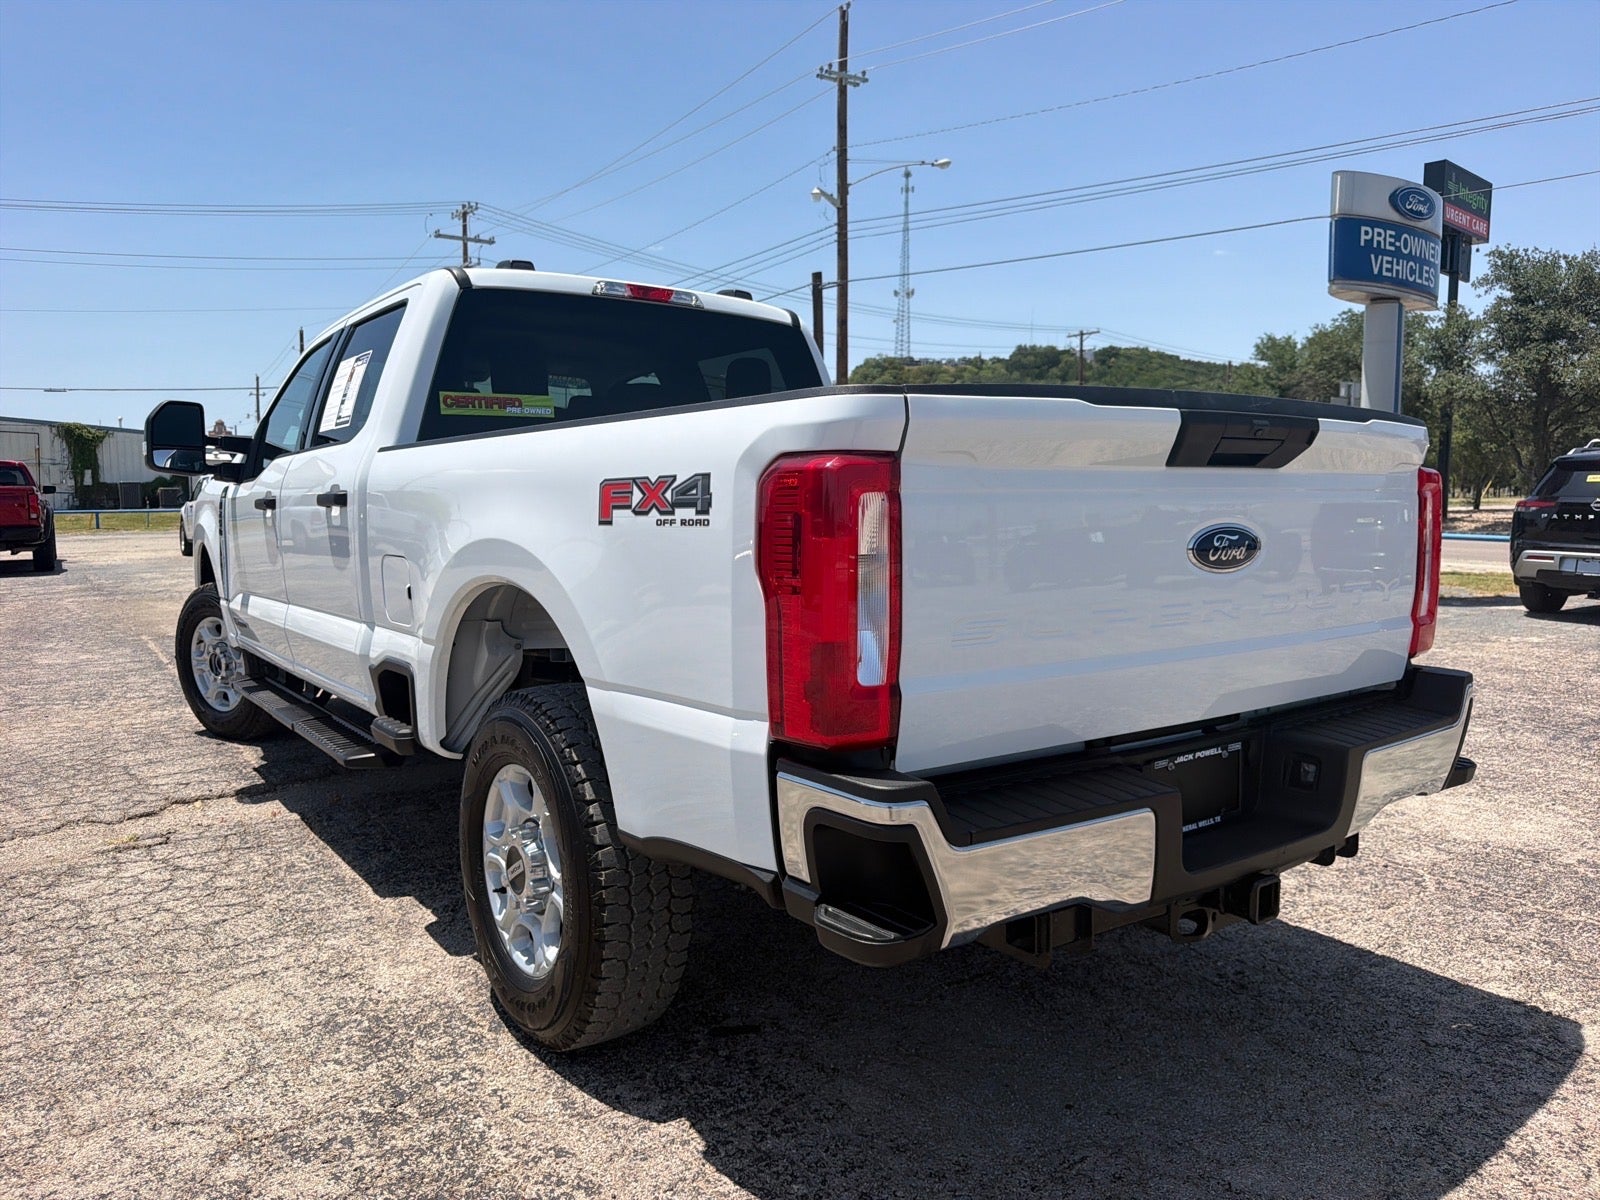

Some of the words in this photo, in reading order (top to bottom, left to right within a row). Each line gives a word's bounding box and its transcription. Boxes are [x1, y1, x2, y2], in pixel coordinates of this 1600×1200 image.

[1405, 193, 1430, 213] Ford
[1459, 182, 1488, 214] Integrity
[1446, 206, 1470, 227] URGENT
[1471, 218, 1487, 235] CARE
[1360, 226, 1440, 264] PRE-OWNED
[1370, 254, 1436, 288] VEHICLES
[442, 394, 523, 409] CERTIFIED
[506, 406, 552, 415] PRE-OWNED
[598, 472, 712, 525] FX4
[655, 518, 677, 527] OFF
[680, 518, 710, 527] ROAD
[1208, 534, 1249, 562] Ford
[1174, 753, 1194, 764] JACK
[1195, 747, 1222, 759] POWELL
